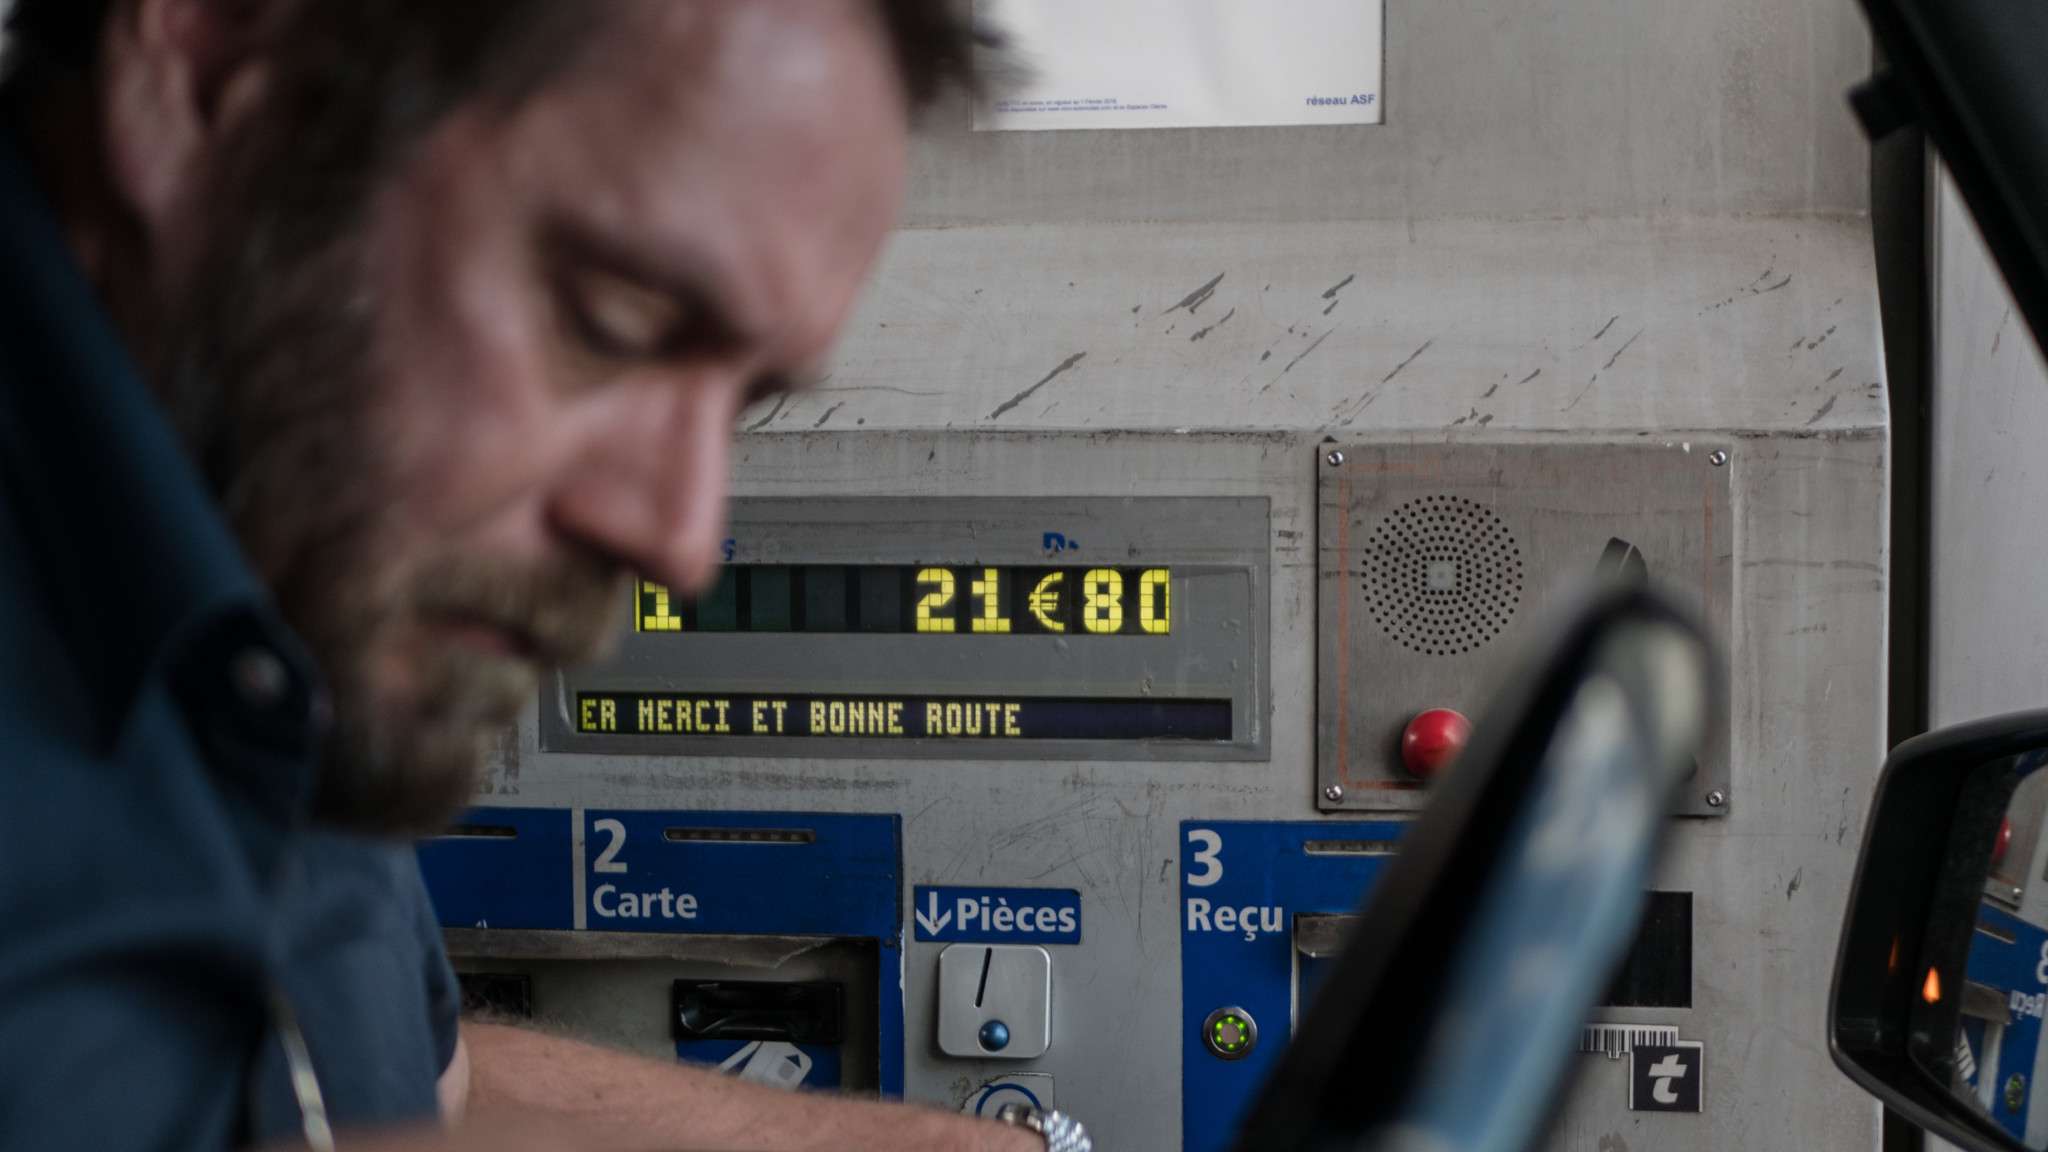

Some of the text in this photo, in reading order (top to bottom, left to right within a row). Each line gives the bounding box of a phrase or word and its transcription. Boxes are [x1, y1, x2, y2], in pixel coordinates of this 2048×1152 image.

[1306, 94, 1376, 106] réseau ASF
[581, 699, 1021, 736] ER MERCI ET BONNE ROUTE
[593, 818, 628, 874] 2
[1187, 829, 1224, 887] 3
[592, 883, 698, 919] Carte
[957, 897, 1076, 933] Pièces
[1187, 898, 1283, 941] Reçu
